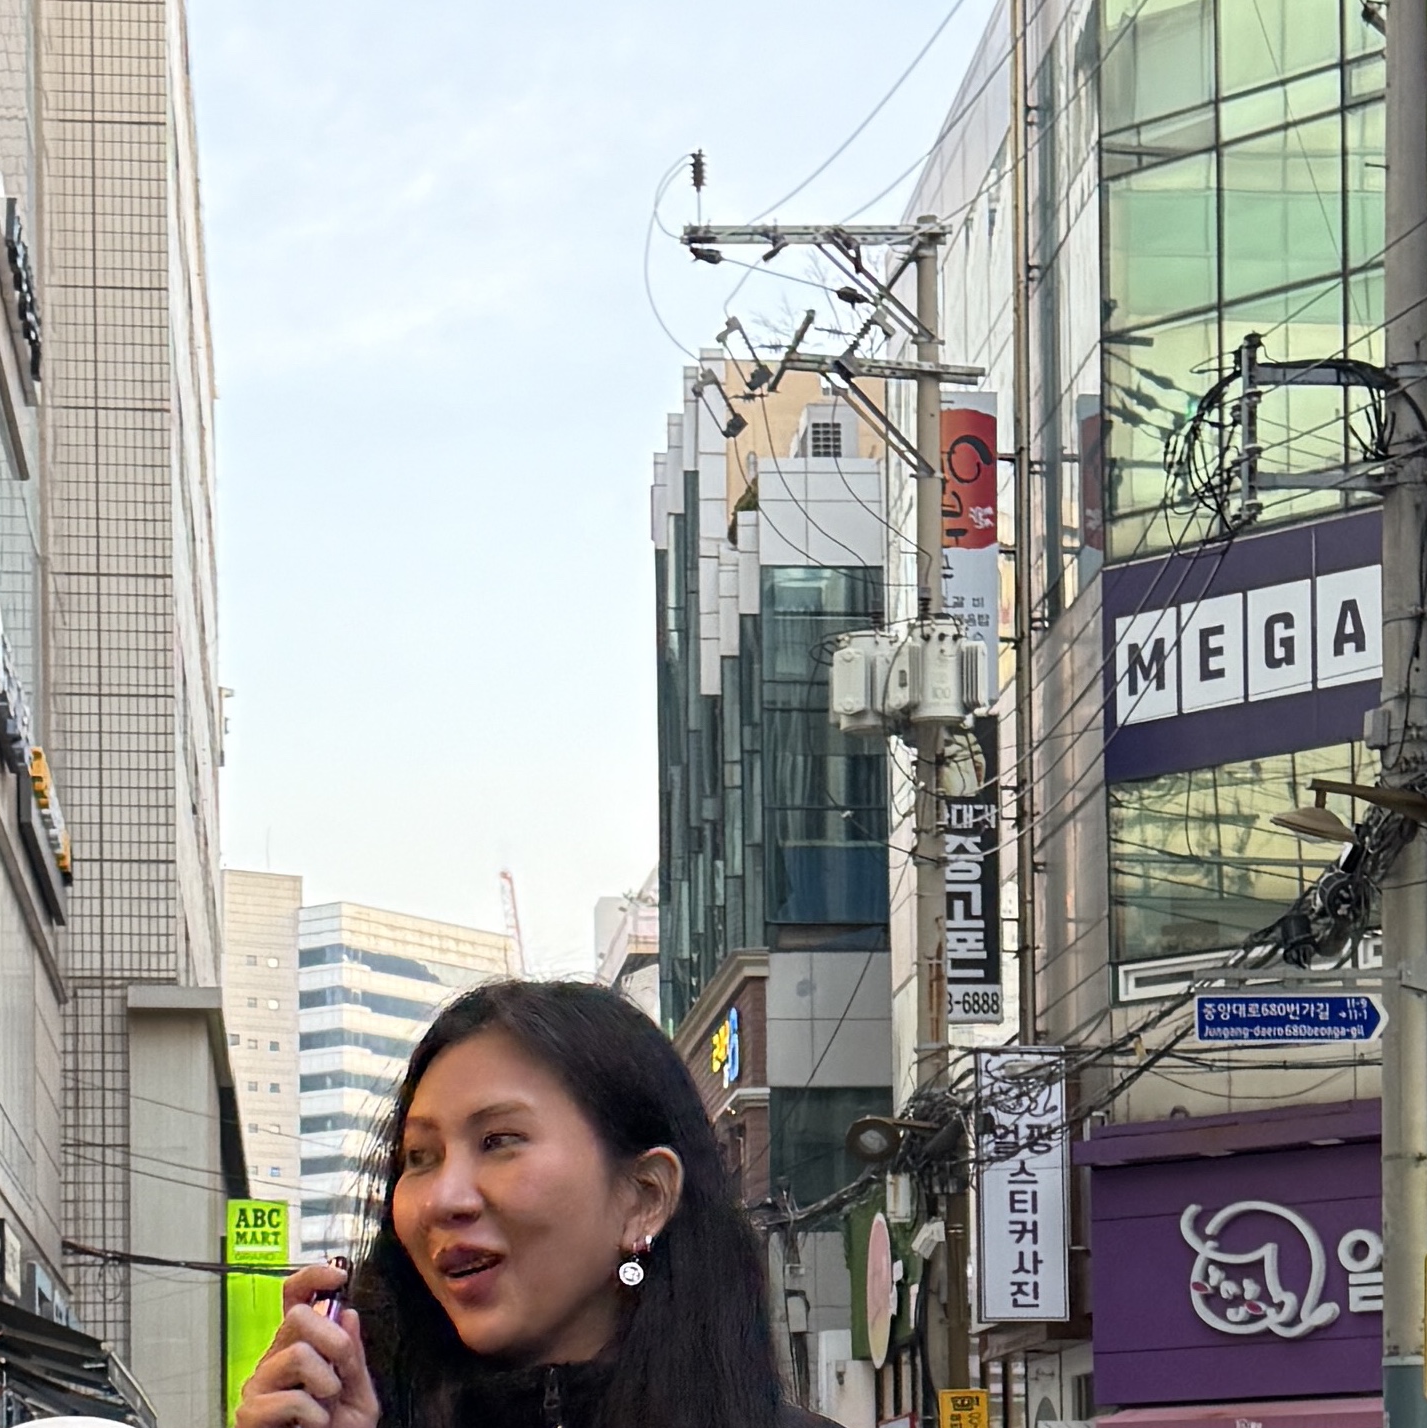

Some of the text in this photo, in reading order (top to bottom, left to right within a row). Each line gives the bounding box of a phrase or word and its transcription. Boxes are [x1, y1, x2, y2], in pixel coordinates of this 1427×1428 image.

[235, 1207, 281, 1229] ABC
[235, 1231, 282, 1246] MART
[1007, 1159, 1045, 1310] 스티커사진
